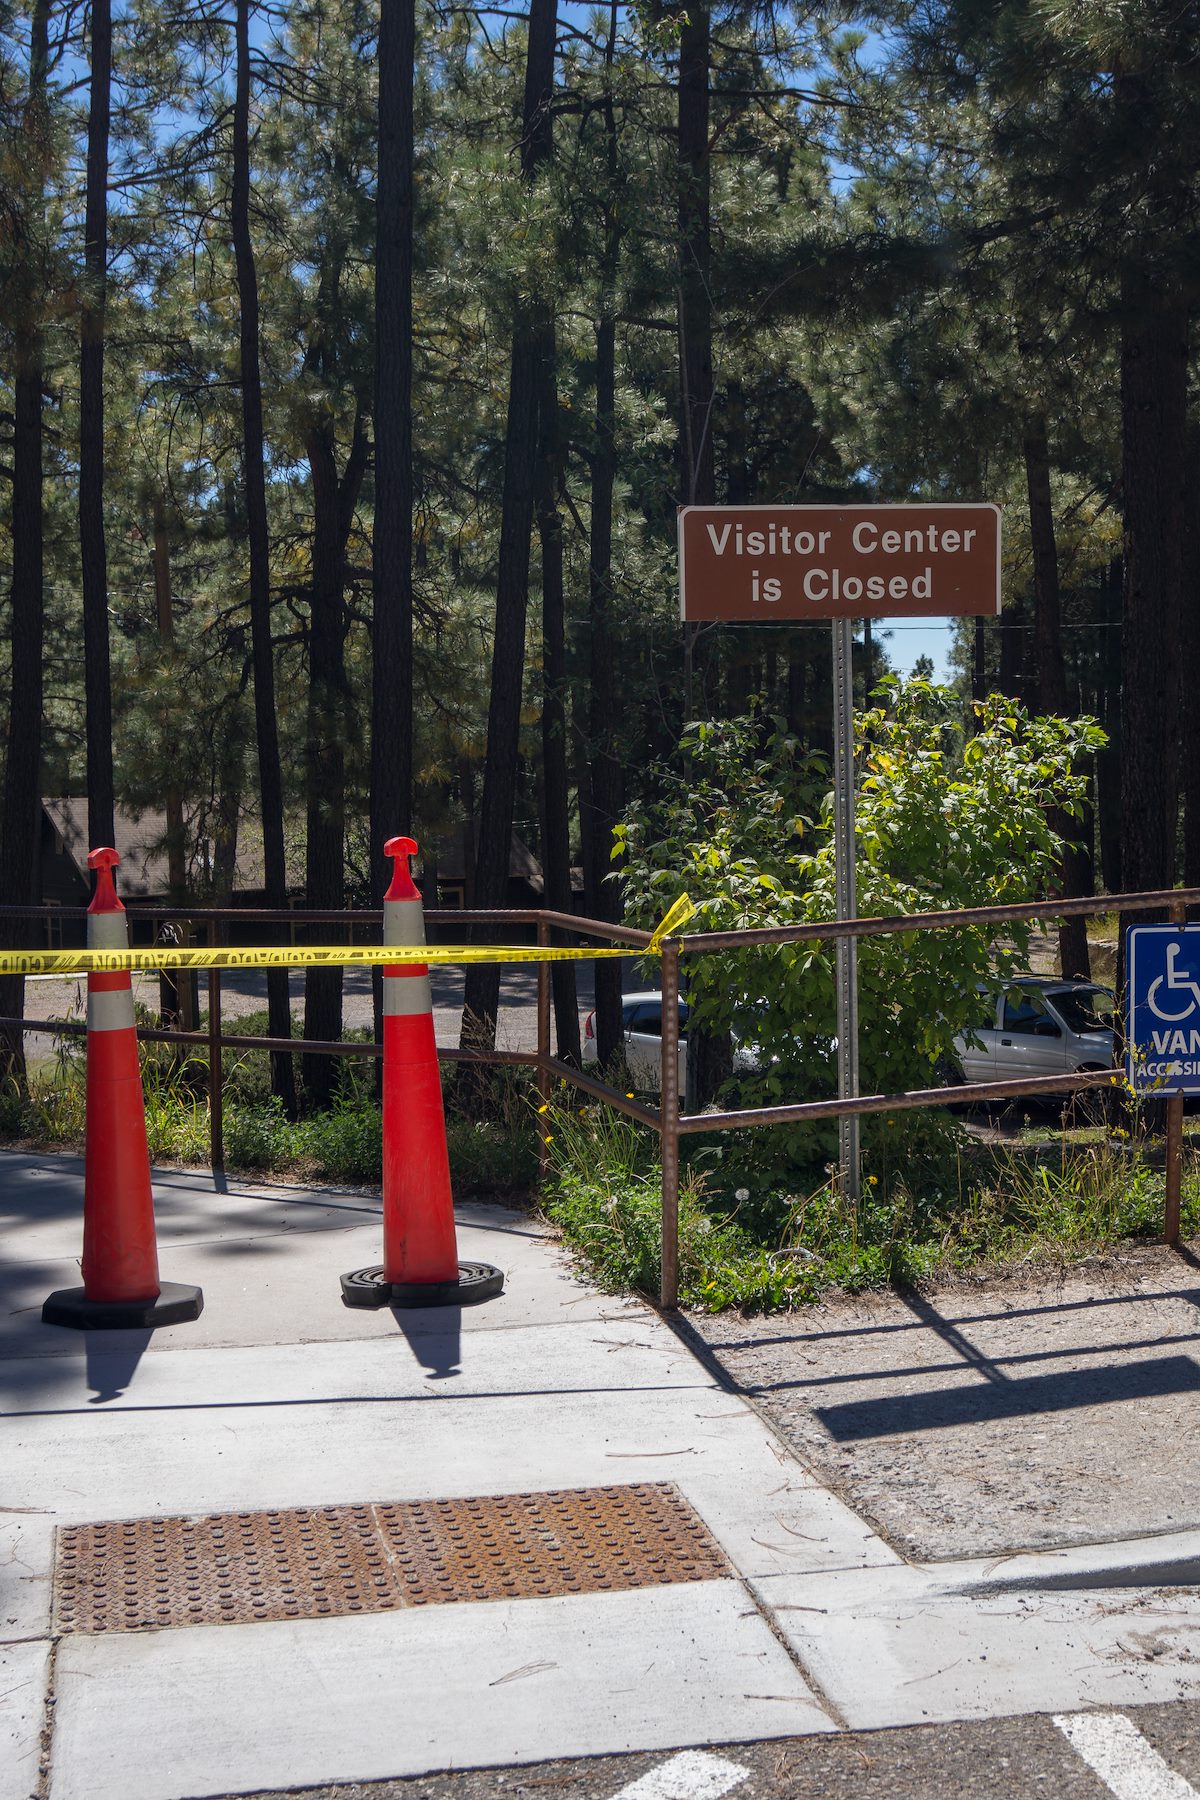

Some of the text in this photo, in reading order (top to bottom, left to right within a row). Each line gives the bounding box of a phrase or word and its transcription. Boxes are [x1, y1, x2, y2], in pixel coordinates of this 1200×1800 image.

[706, 521, 977, 555] Visitor Center
[752, 568, 932, 601] is Closed
[0, 955, 45, 972] CUID
[93, 953, 182, 970] CAUTION
[1152, 1029, 1200, 1054] VAN
[1137, 1062, 1200, 1077] ACCESSI
